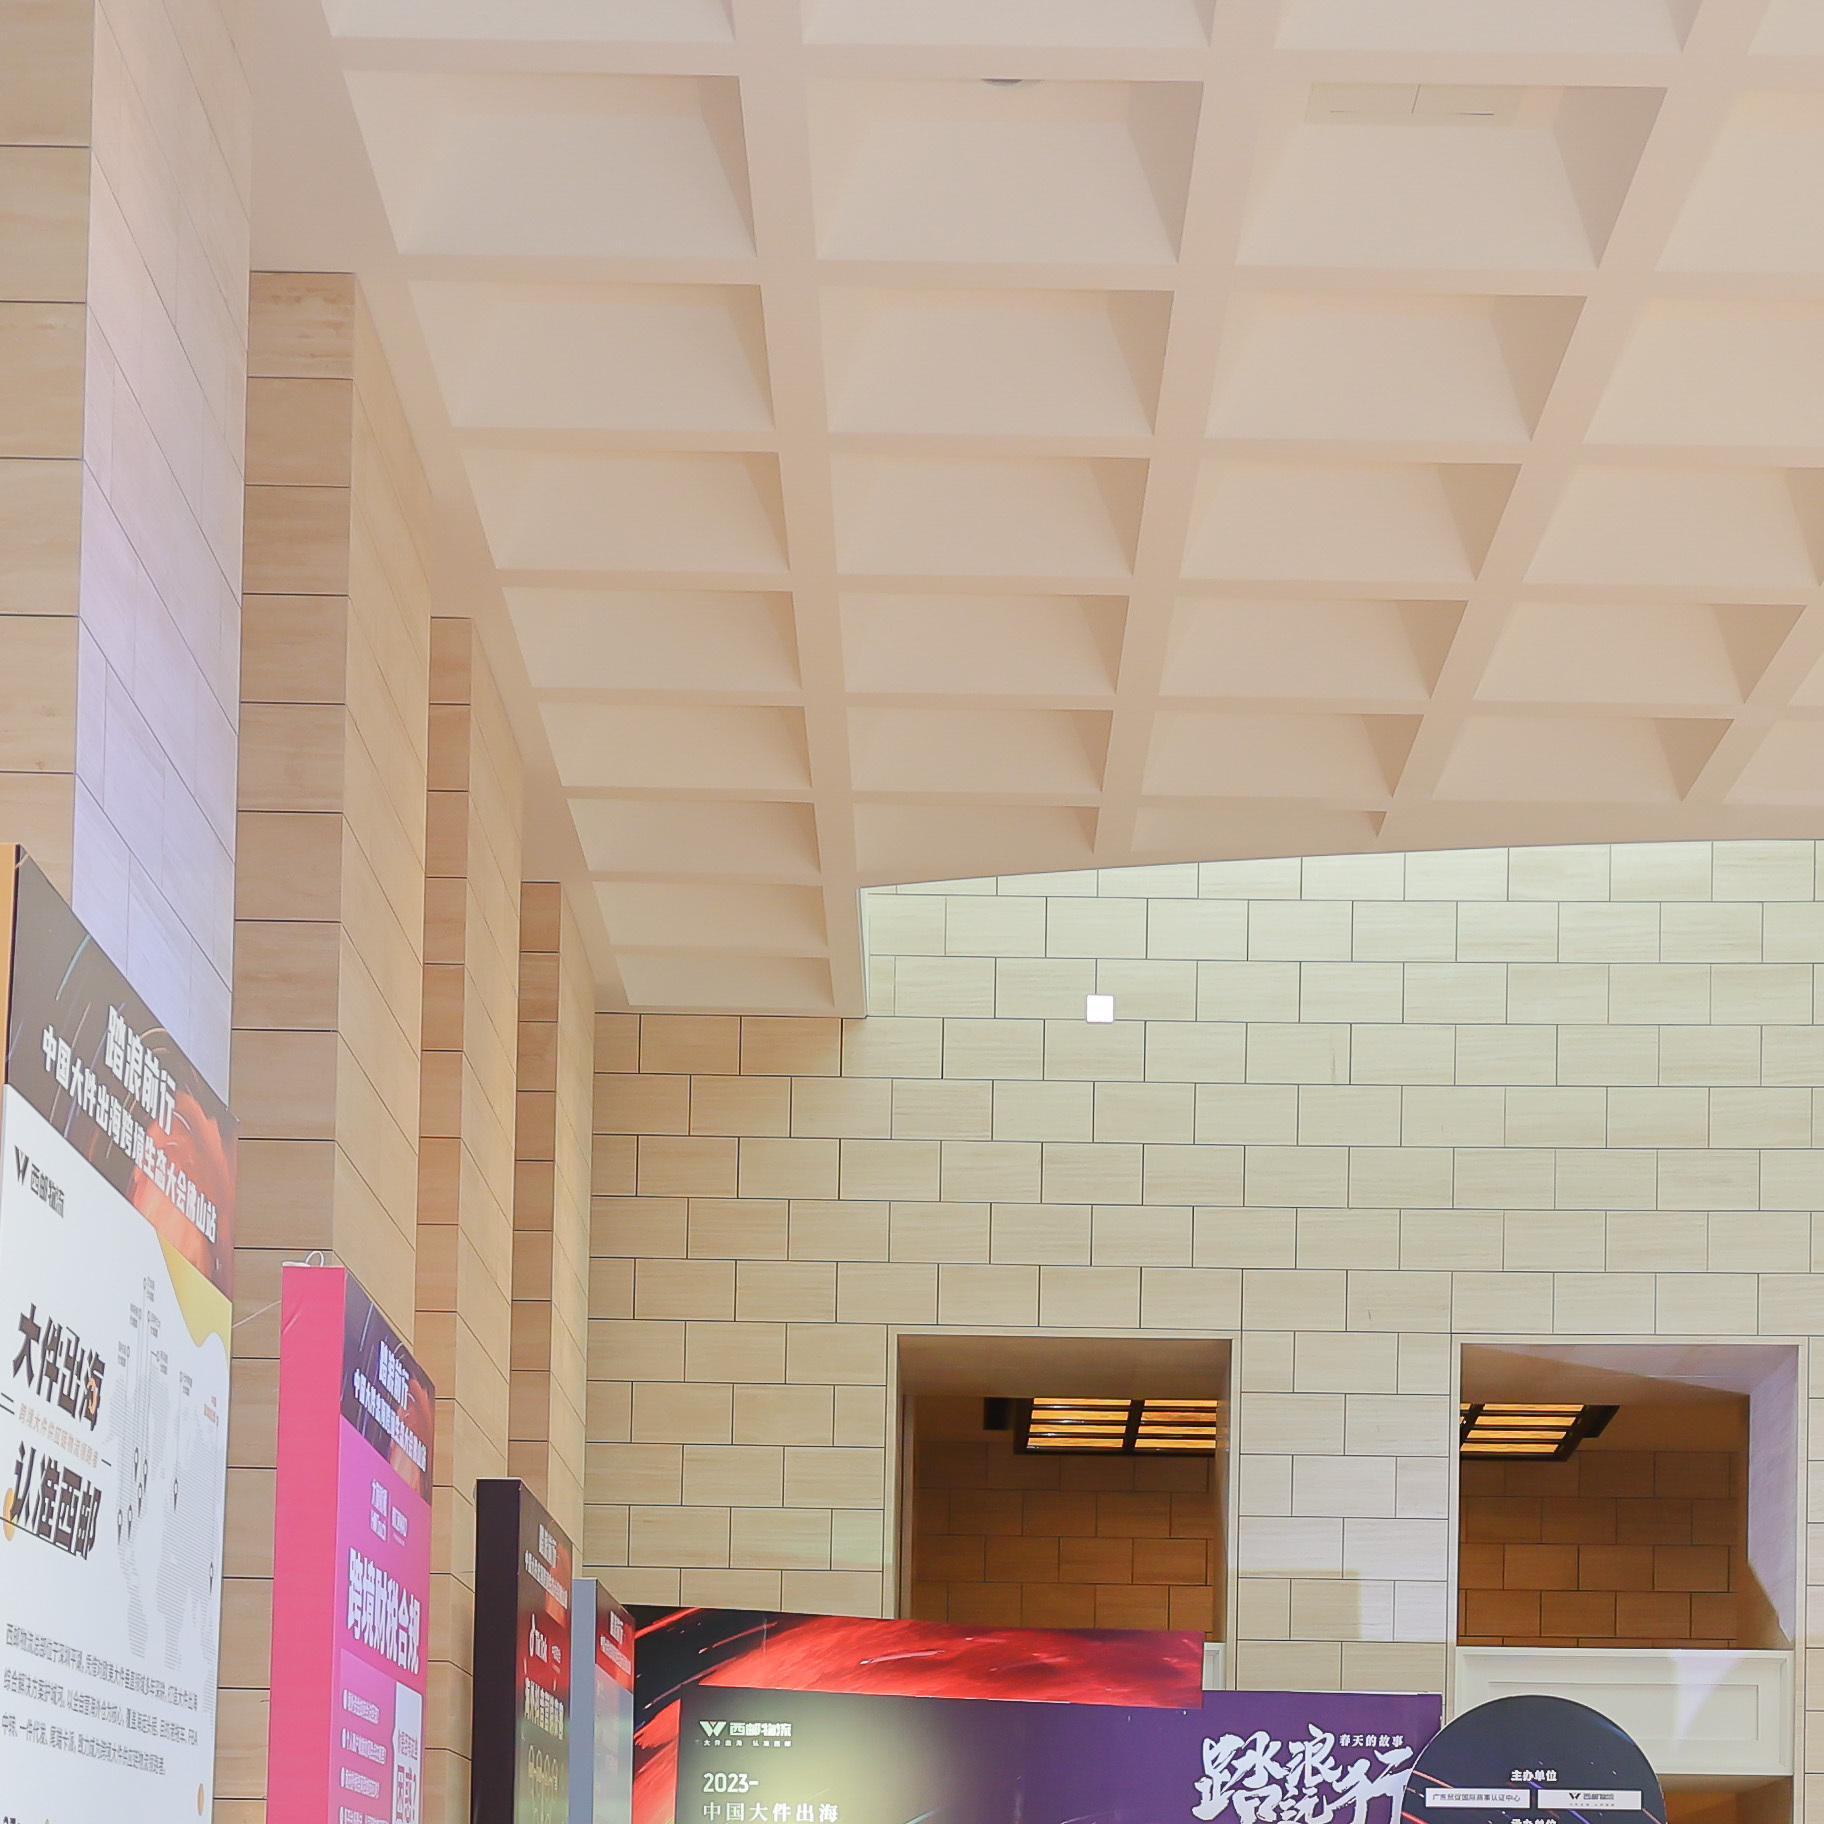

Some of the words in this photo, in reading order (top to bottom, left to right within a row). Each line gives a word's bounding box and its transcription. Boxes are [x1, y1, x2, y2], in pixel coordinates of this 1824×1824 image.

[106, 1005, 178, 1136] 踏浪前行
[42, 1024, 219, 1244] 中国大件出海跨境生态大会佛山站
[13, 1302, 106, 1431] 大件出海
[10, 1440, 103, 1560] 认准西邮
[729, 1721, 793, 1738] 西邮物流
[1339, 1733, 1405, 1748] 春天的故事
[702, 1773, 760, 1794] 2023-
[1510, 1769, 1558, 1782] 主办单位
[702, 1802, 839, 1823] 中国大件出海
